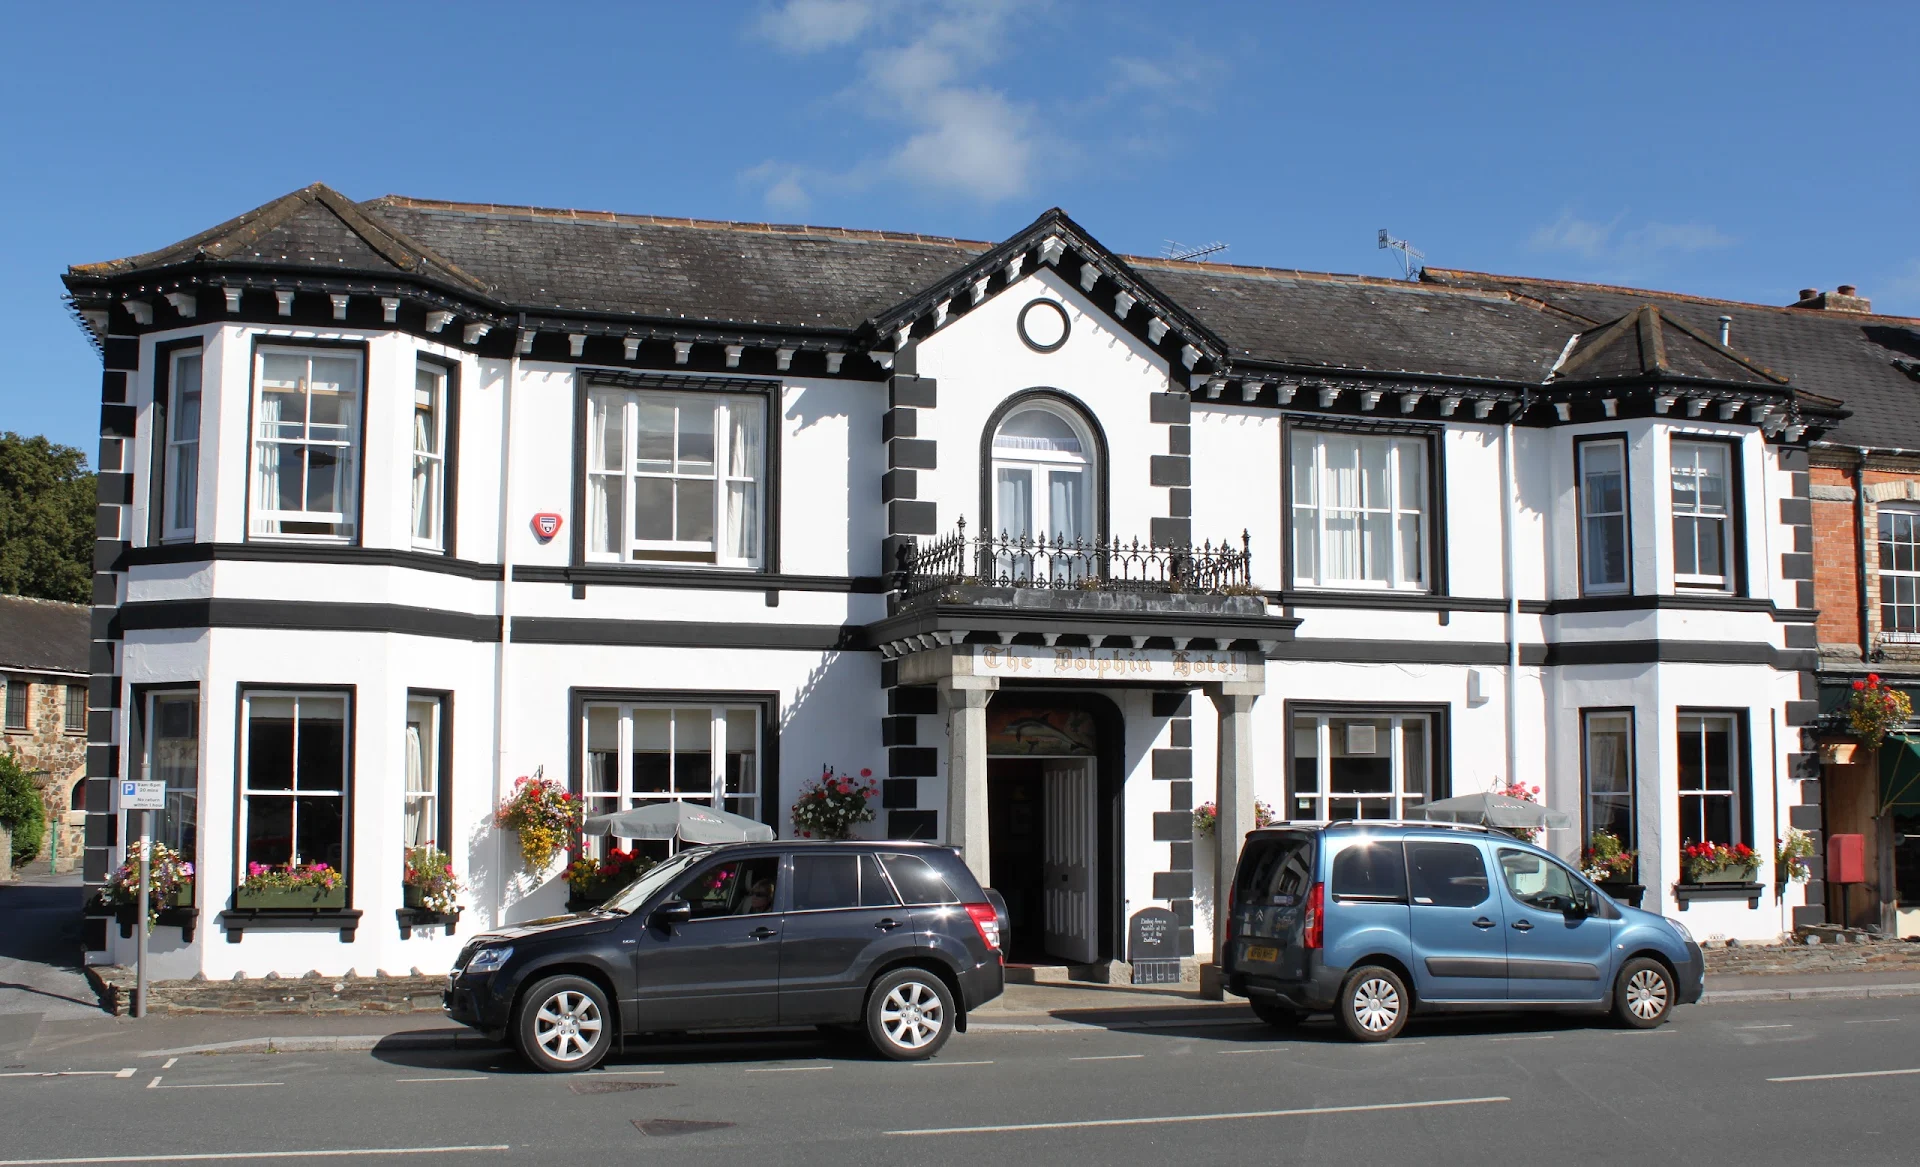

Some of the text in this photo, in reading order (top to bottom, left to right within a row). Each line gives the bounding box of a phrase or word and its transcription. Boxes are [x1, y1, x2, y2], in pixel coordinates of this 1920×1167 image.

[982, 645, 1237, 679] The Dolphin Hotel
[125, 784, 134, 794] P
